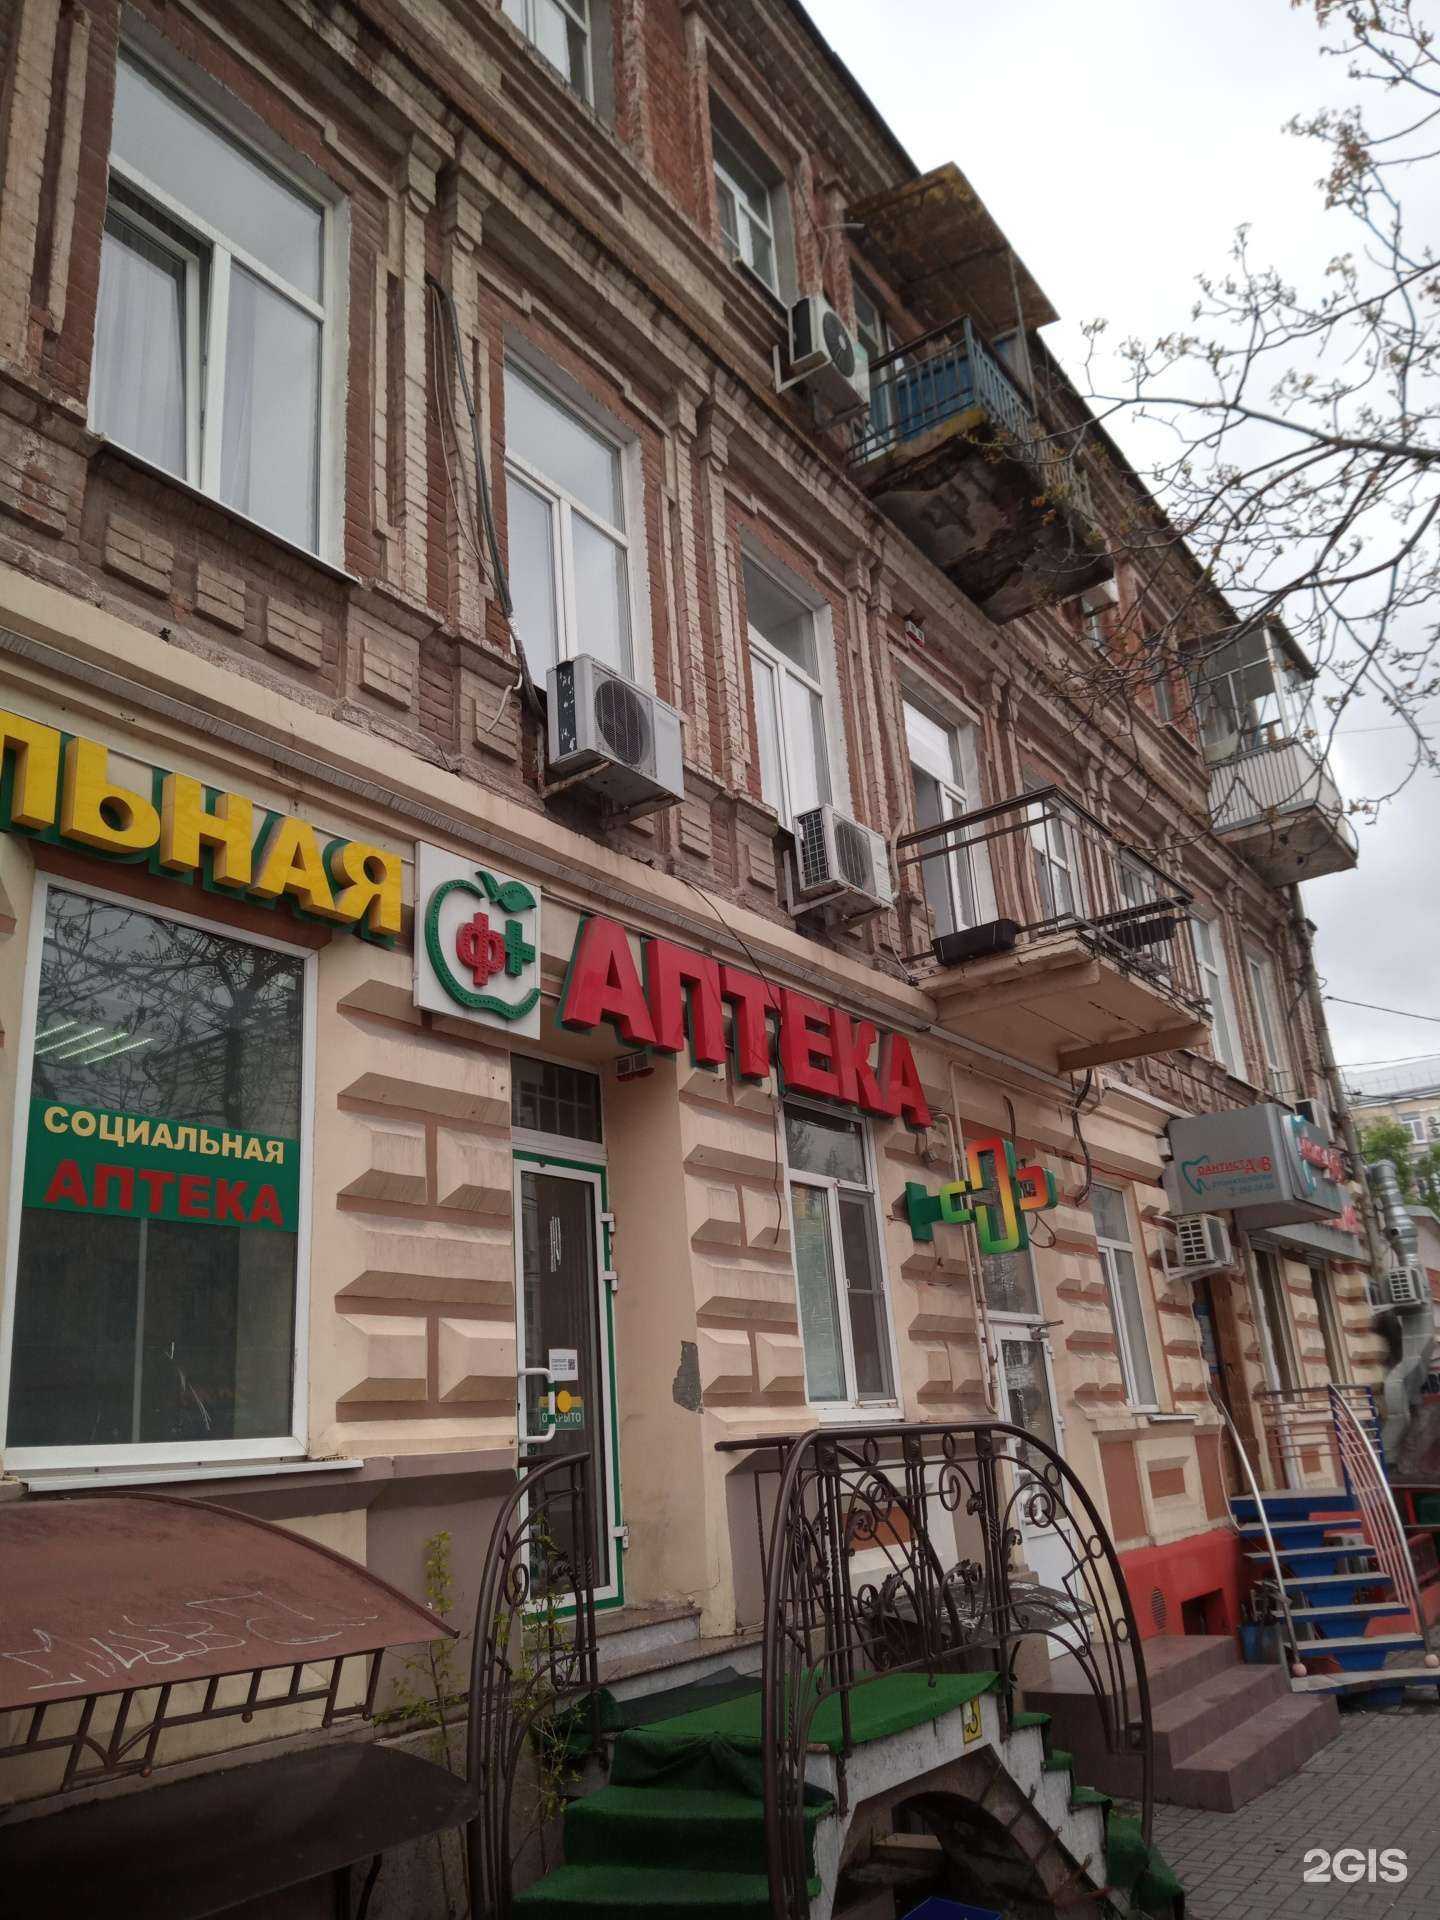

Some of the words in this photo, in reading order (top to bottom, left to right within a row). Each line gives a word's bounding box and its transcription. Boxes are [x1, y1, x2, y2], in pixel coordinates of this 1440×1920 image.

[561, 915, 932, 1127] АПТЕКА
[44, 1106, 285, 1165] СОЦИАЛЬНАЯ
[43, 1159, 285, 1227] АПТЕКА
